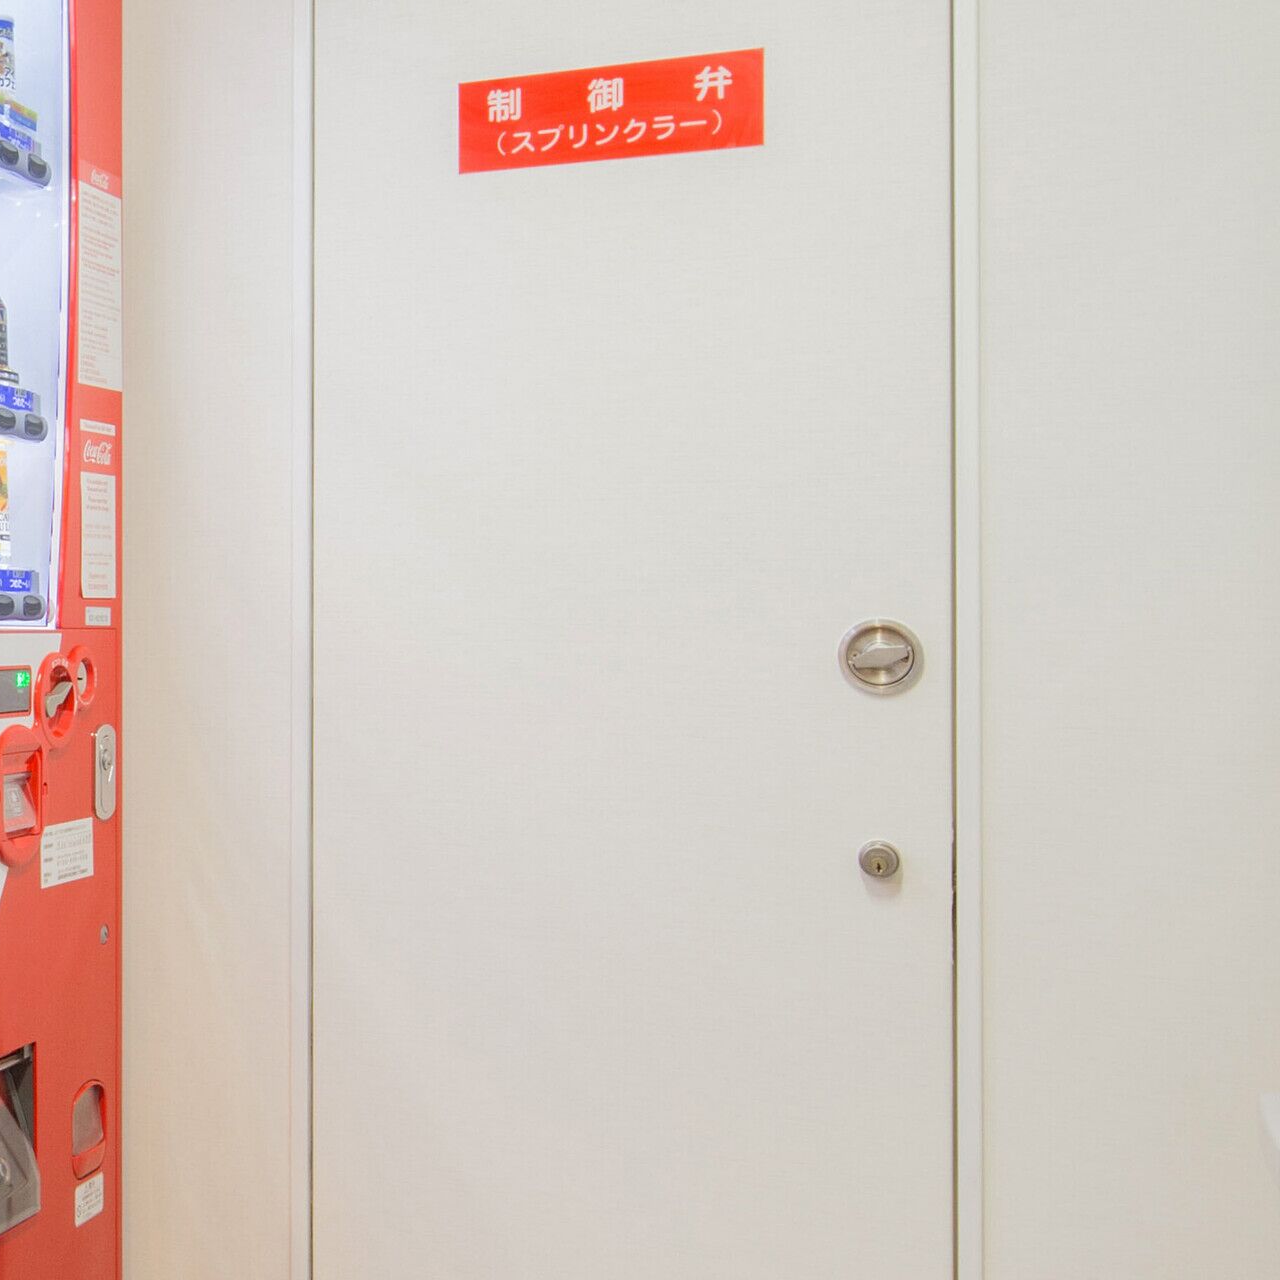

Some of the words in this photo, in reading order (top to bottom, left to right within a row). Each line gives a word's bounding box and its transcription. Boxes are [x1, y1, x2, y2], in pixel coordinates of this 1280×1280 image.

[486, 65, 733, 124] 制御弁
[497, 108, 722, 157] (スプリンクラー)
